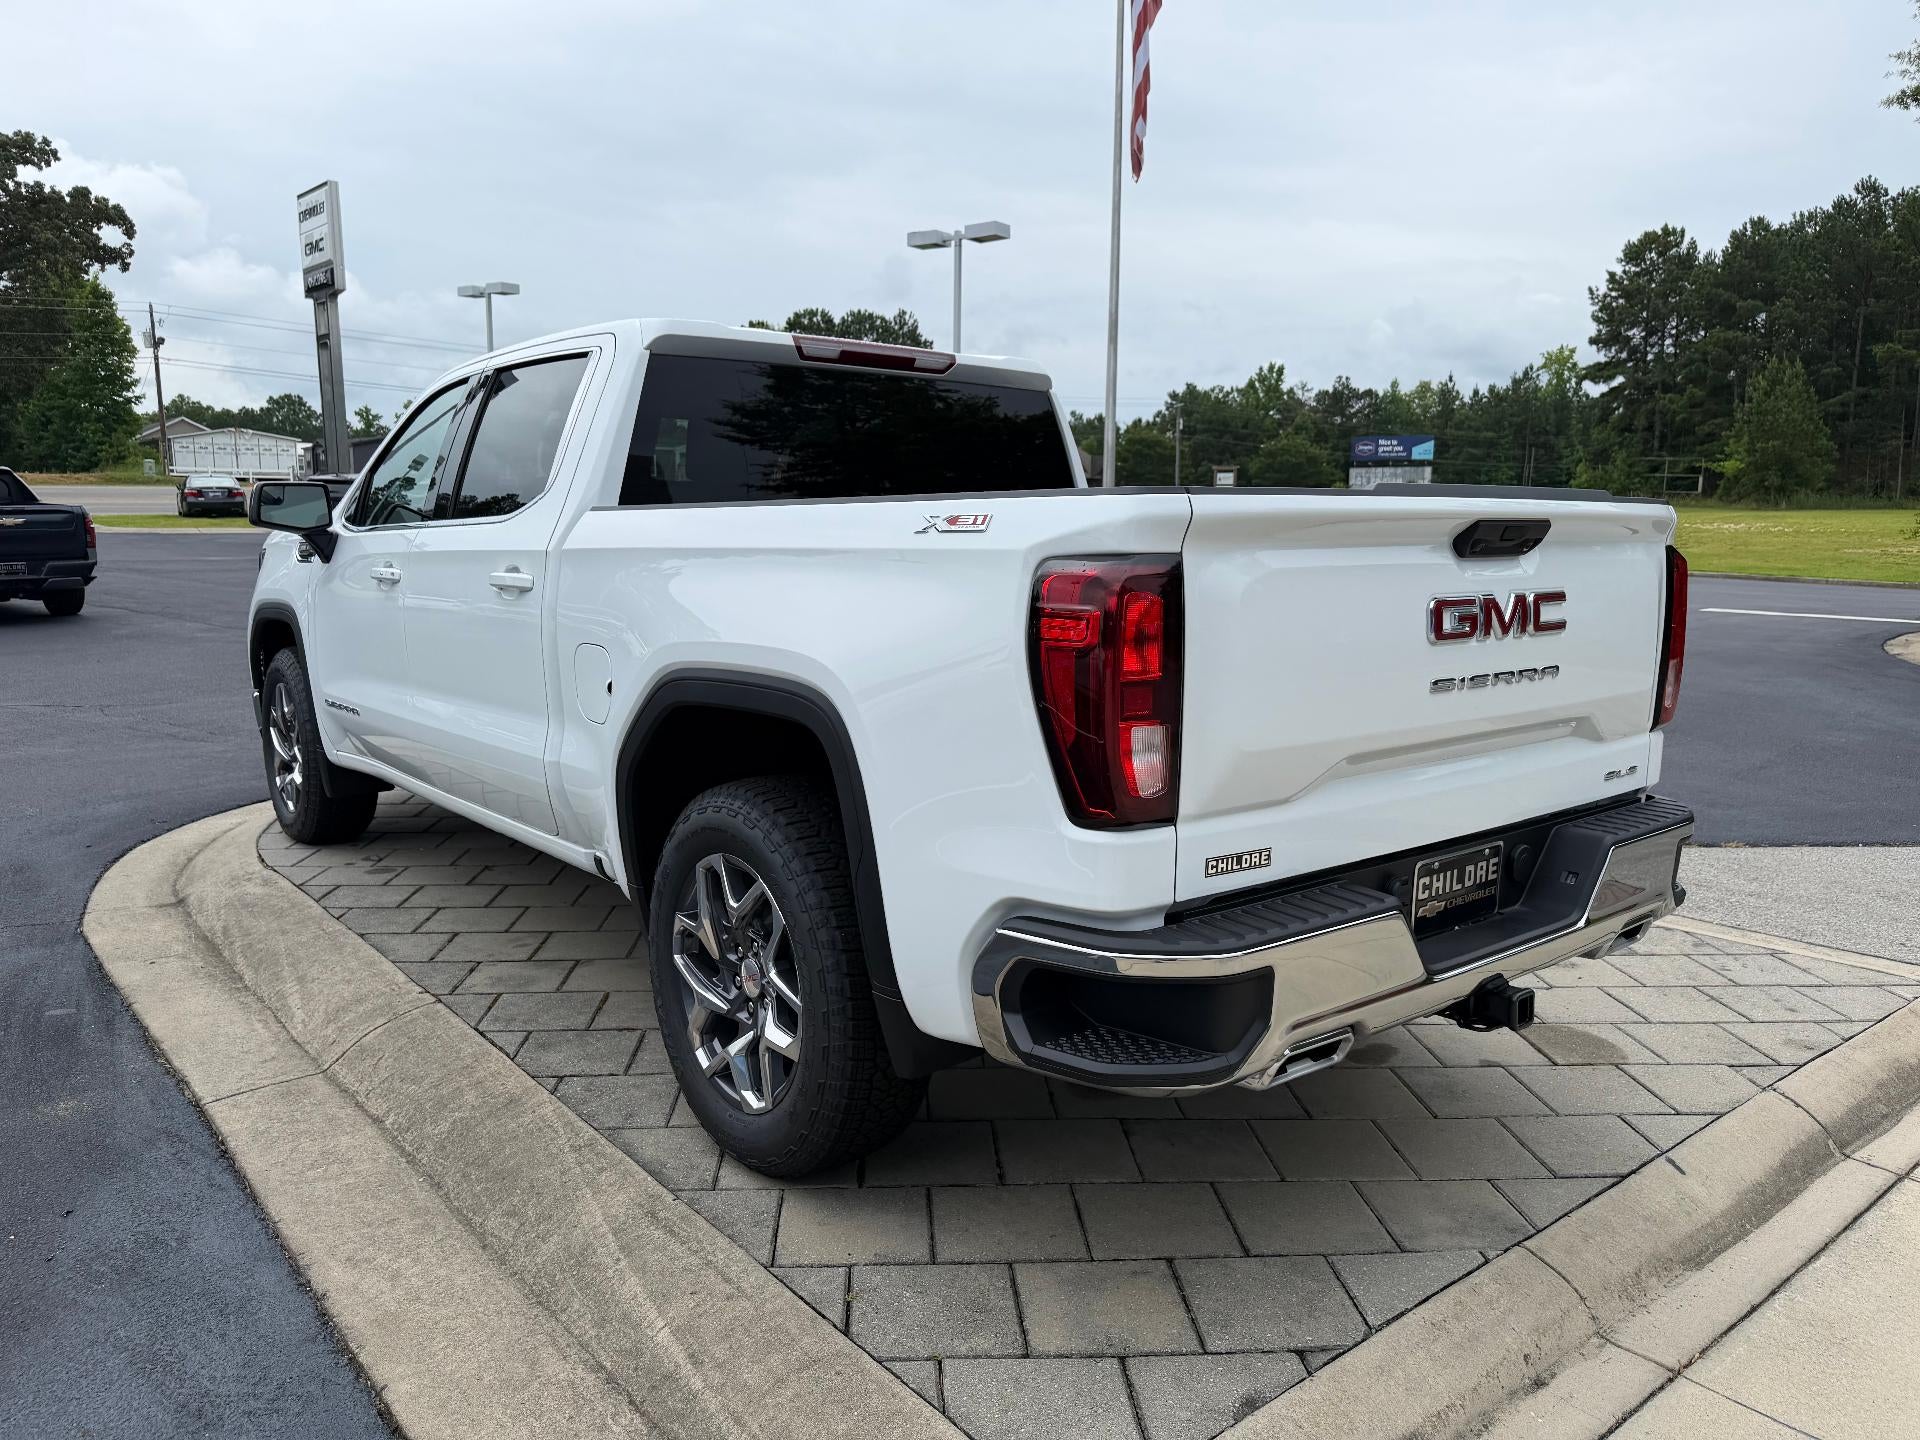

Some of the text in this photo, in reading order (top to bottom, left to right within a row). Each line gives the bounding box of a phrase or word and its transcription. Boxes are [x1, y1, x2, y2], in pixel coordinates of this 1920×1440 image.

[304, 237, 325, 257] GMC
[913, 513, 993, 534] X31
[1426, 588, 1567, 645] GMC
[1429, 664, 1560, 694] SIERRA
[1207, 851, 1270, 875] CHILDRE
[1417, 857, 1499, 900] CHILDRE
[1447, 886, 1497, 909] CHEVROLET
